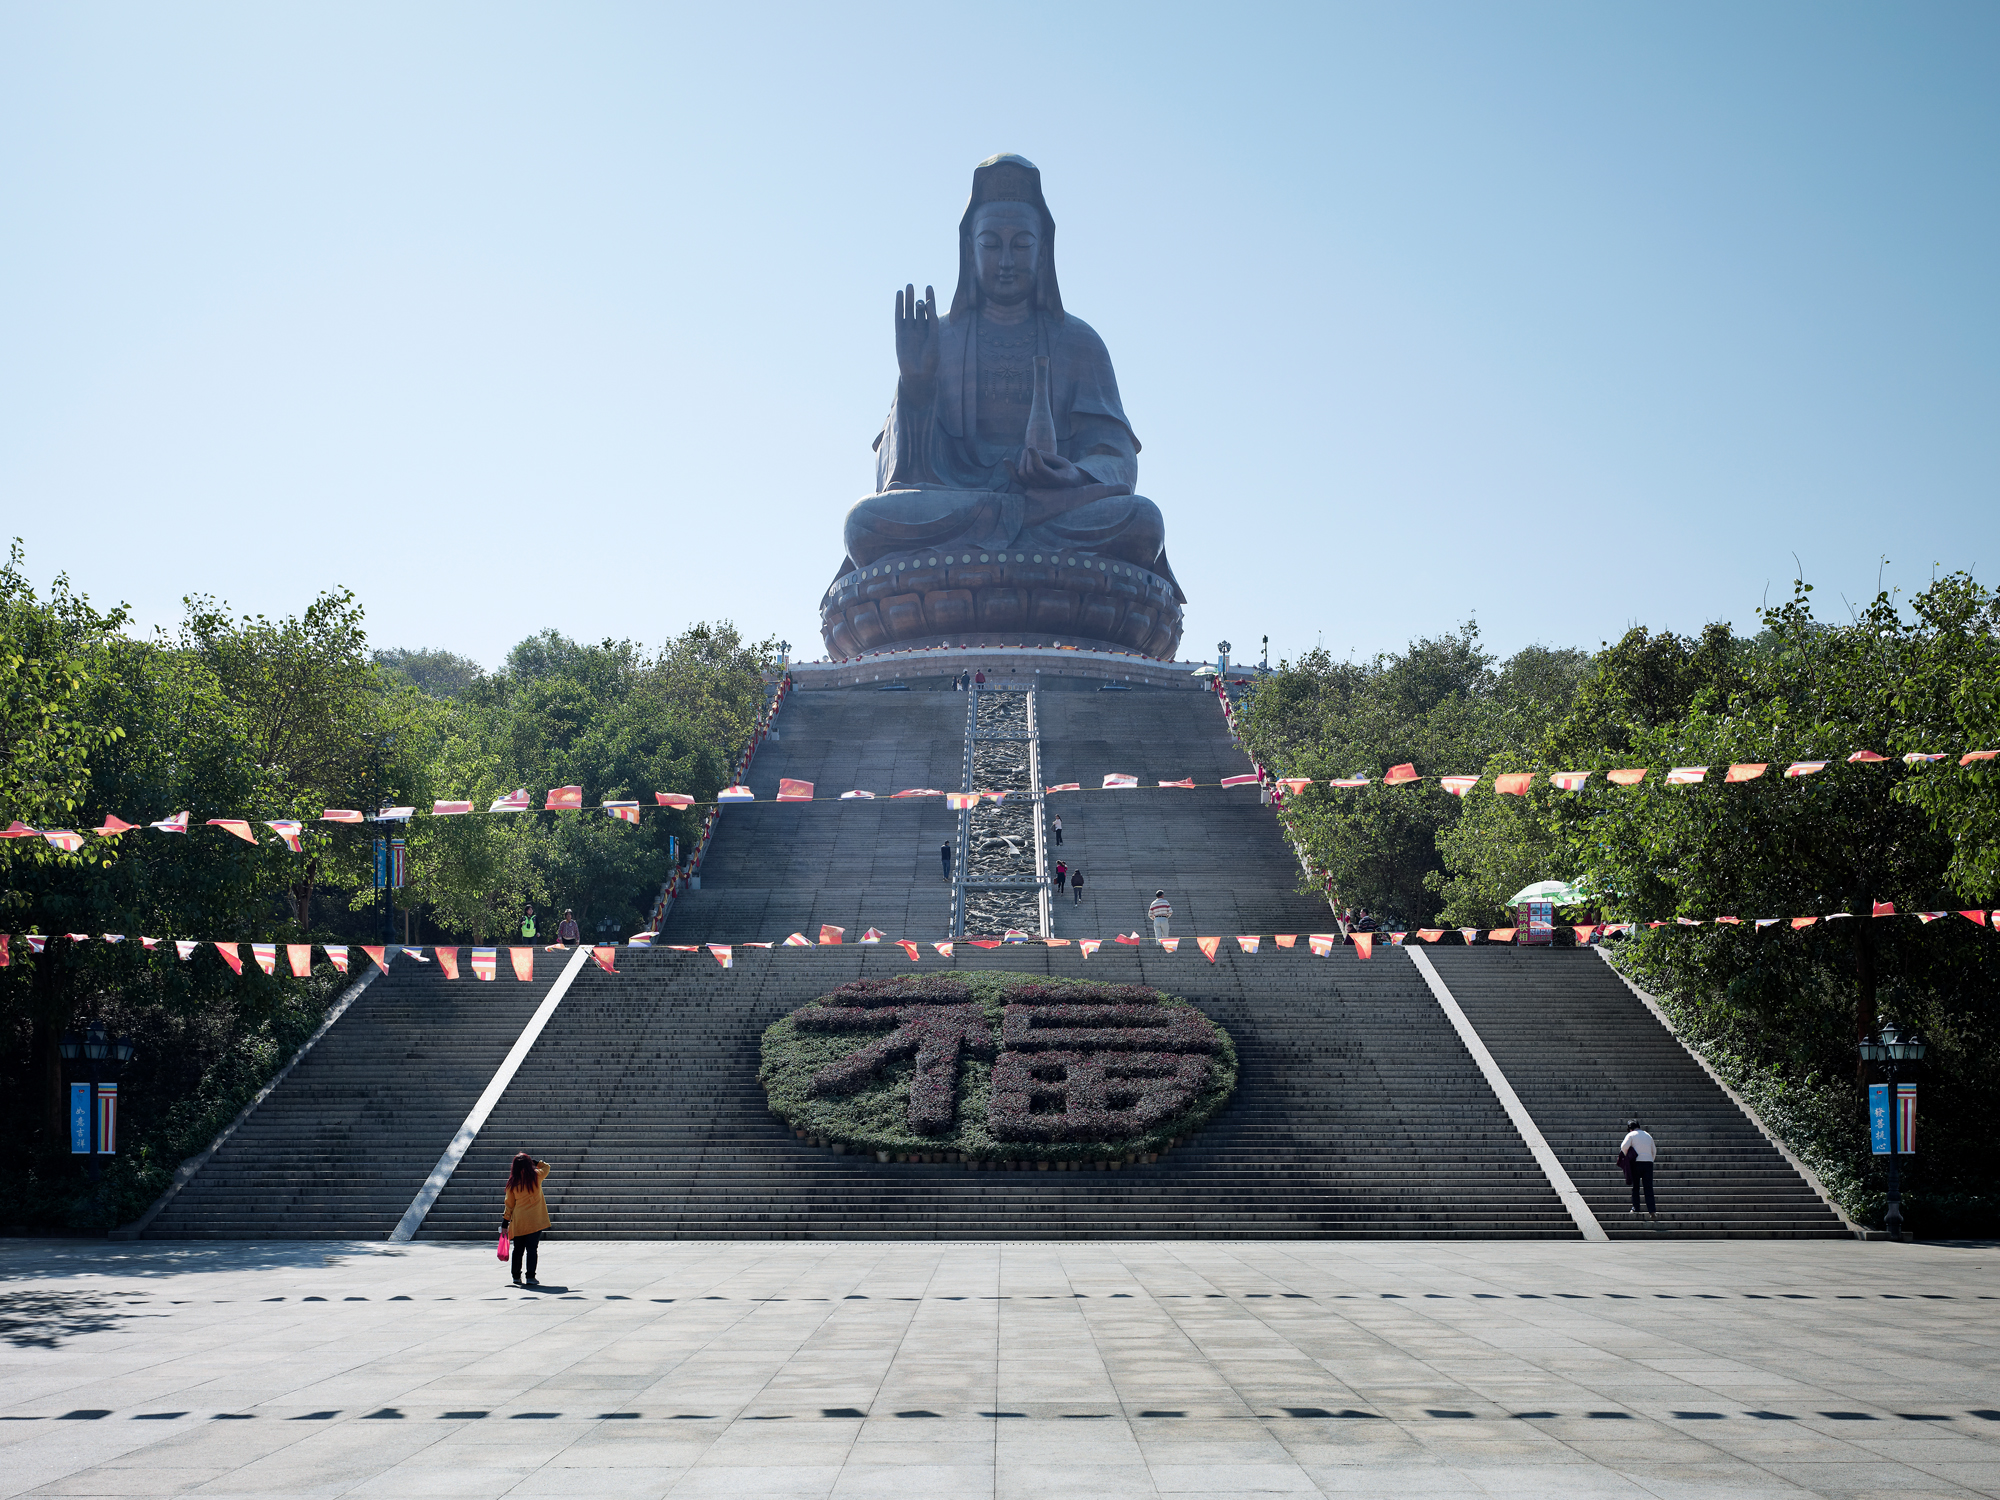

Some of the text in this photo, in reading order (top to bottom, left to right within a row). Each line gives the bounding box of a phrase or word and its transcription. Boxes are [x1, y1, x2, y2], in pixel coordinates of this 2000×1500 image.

[791, 977, 1217, 1143] 福
[75, 1106, 86, 1149] 如意吉祥
[1874, 1107, 1887, 1150] 發菩提心
